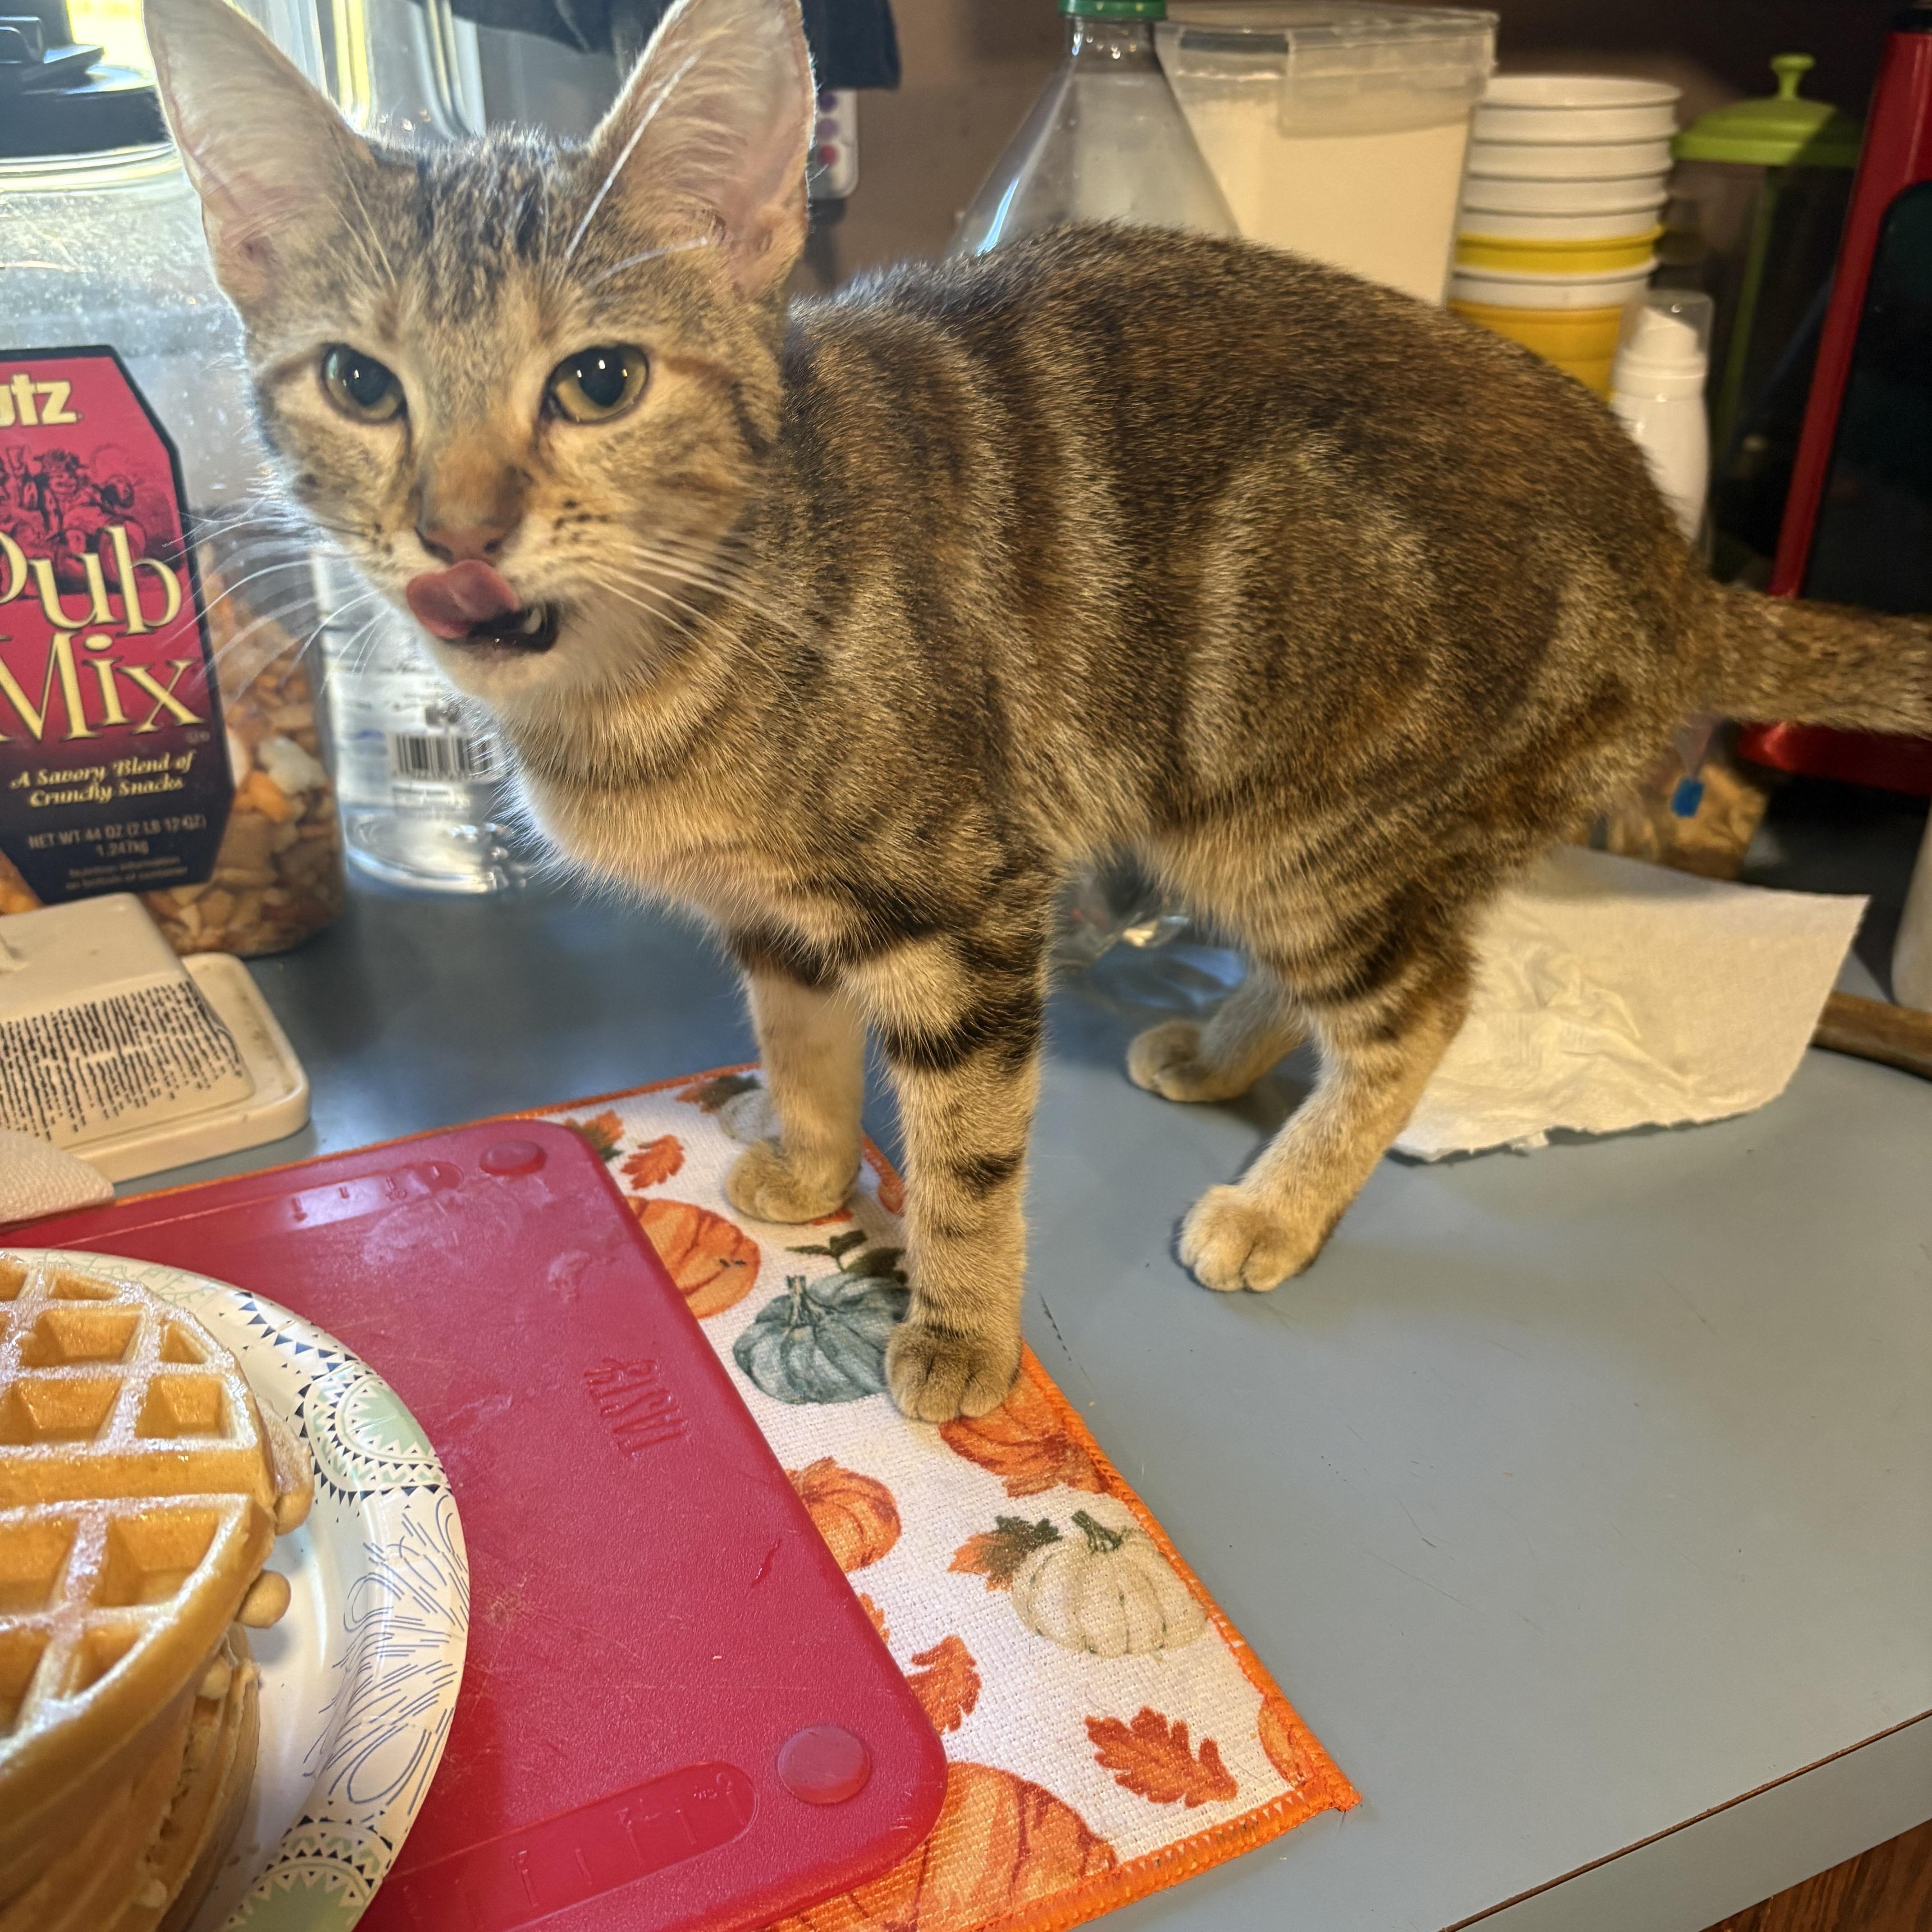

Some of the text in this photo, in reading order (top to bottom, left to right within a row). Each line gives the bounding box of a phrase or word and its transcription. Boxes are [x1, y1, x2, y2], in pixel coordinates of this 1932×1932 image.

[9, 749, 197, 789] A Savory Blend of
[29, 773, 184, 808] Crunchy Snacks
[28, 833, 55, 850] NET
[58, 829, 81, 846] WT
[85, 827, 102, 842] 44
[104, 824, 123, 840] OZ
[143, 819, 161, 836] LB
[164, 817, 180, 833] 12
